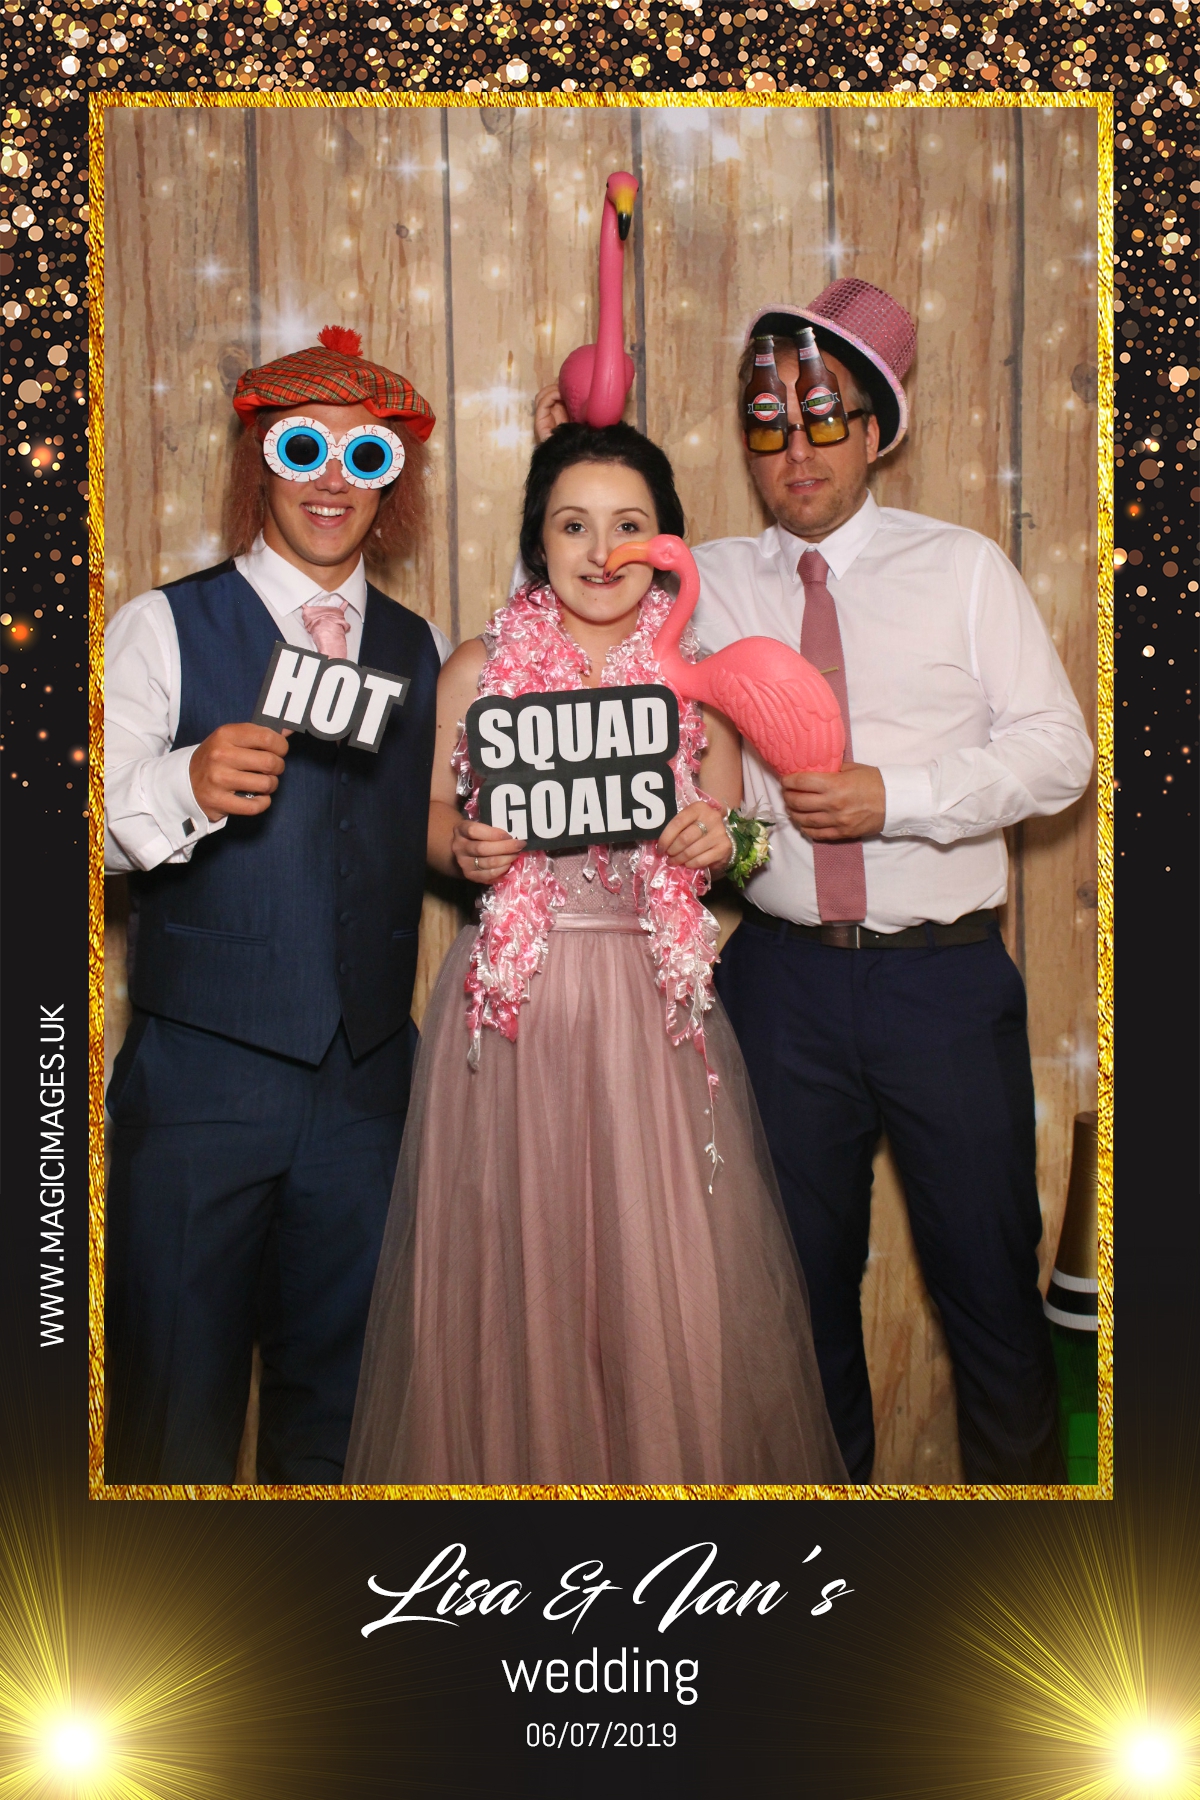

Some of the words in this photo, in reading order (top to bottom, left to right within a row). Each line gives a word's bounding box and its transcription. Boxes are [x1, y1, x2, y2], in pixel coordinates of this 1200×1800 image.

[262, 649, 402, 745] HOT
[479, 697, 668, 770] SQUAD
[490, 772, 666, 840] GOALS
